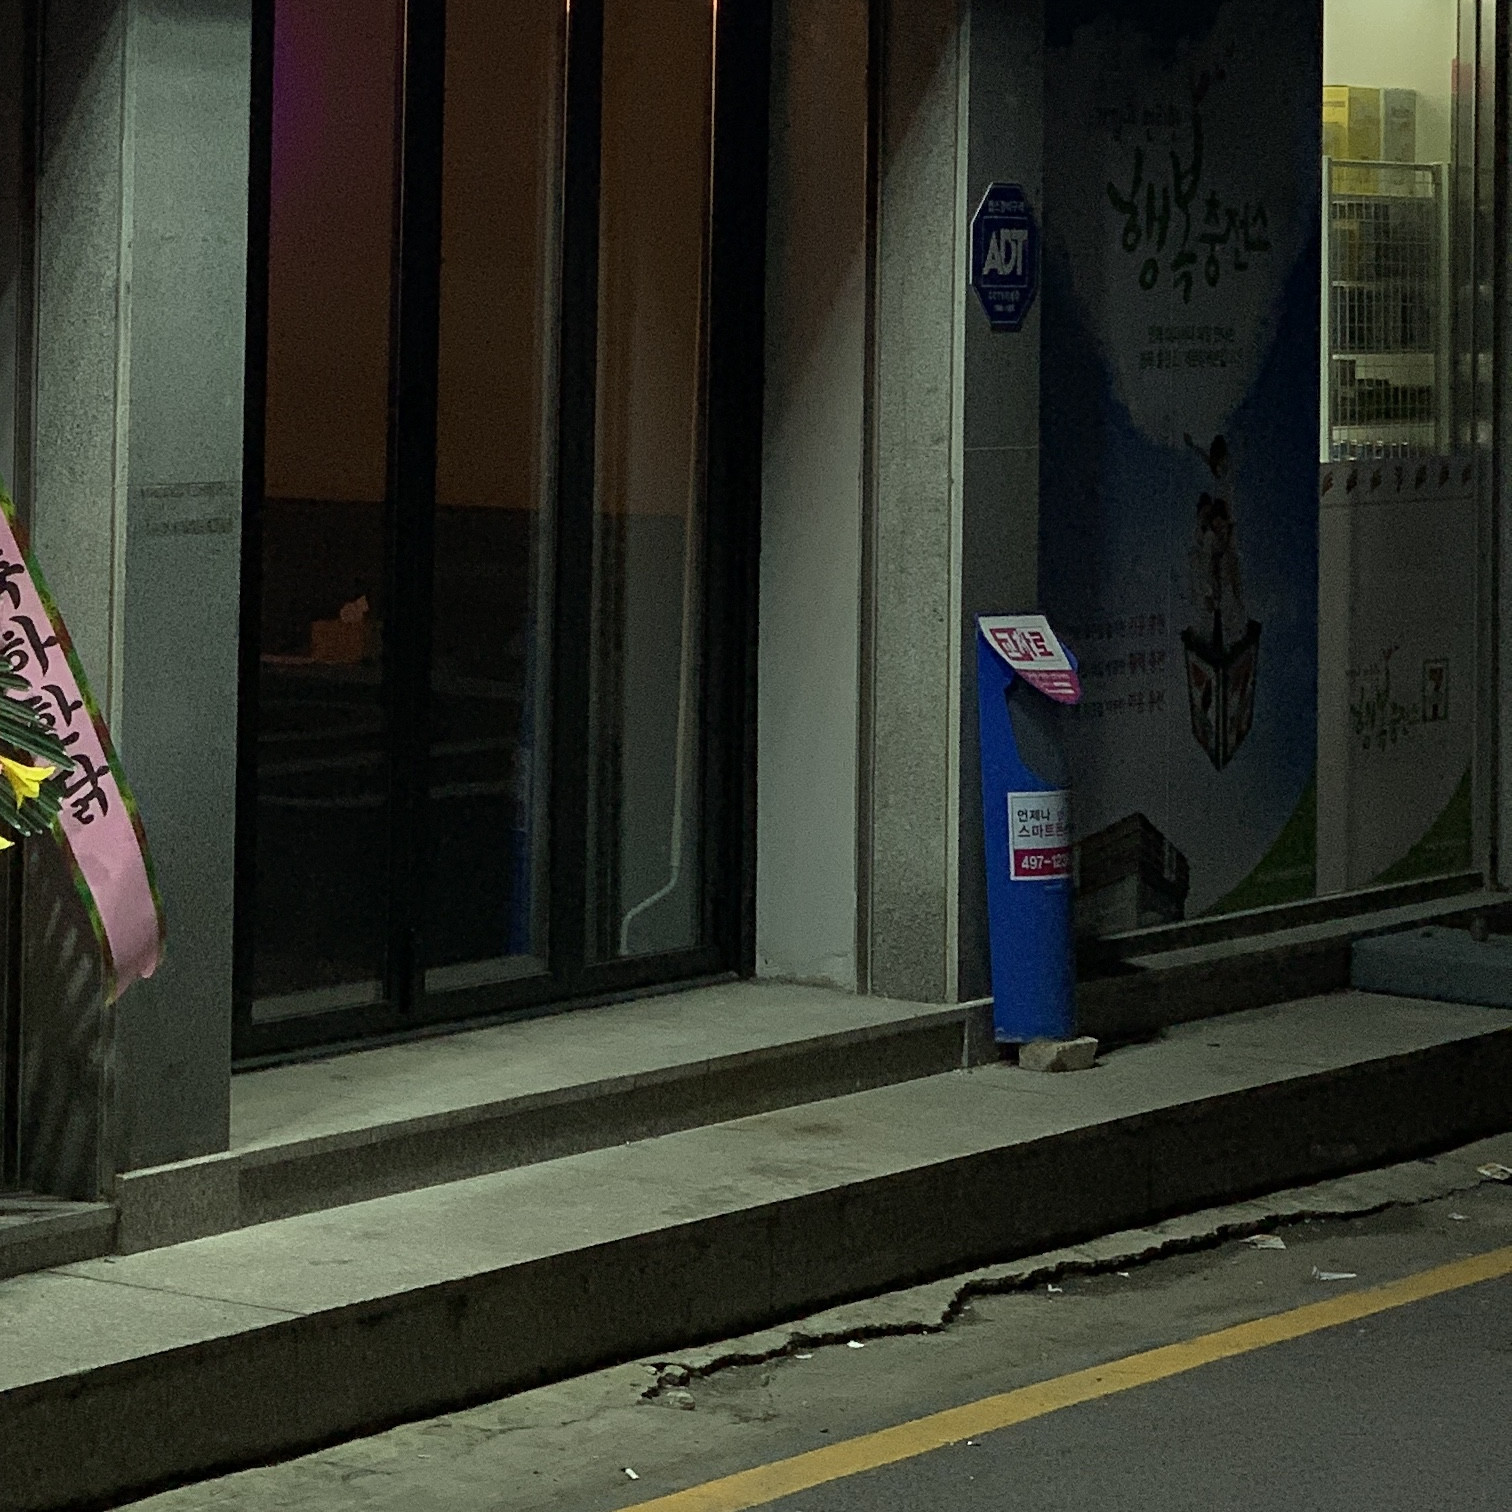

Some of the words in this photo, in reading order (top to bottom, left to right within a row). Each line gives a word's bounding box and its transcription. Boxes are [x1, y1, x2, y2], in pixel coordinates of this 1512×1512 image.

[982, 227, 1029, 276] ADT
[1017, 808, 1051, 823] 언제나
[1021, 853, 1071, 870] 497-123
